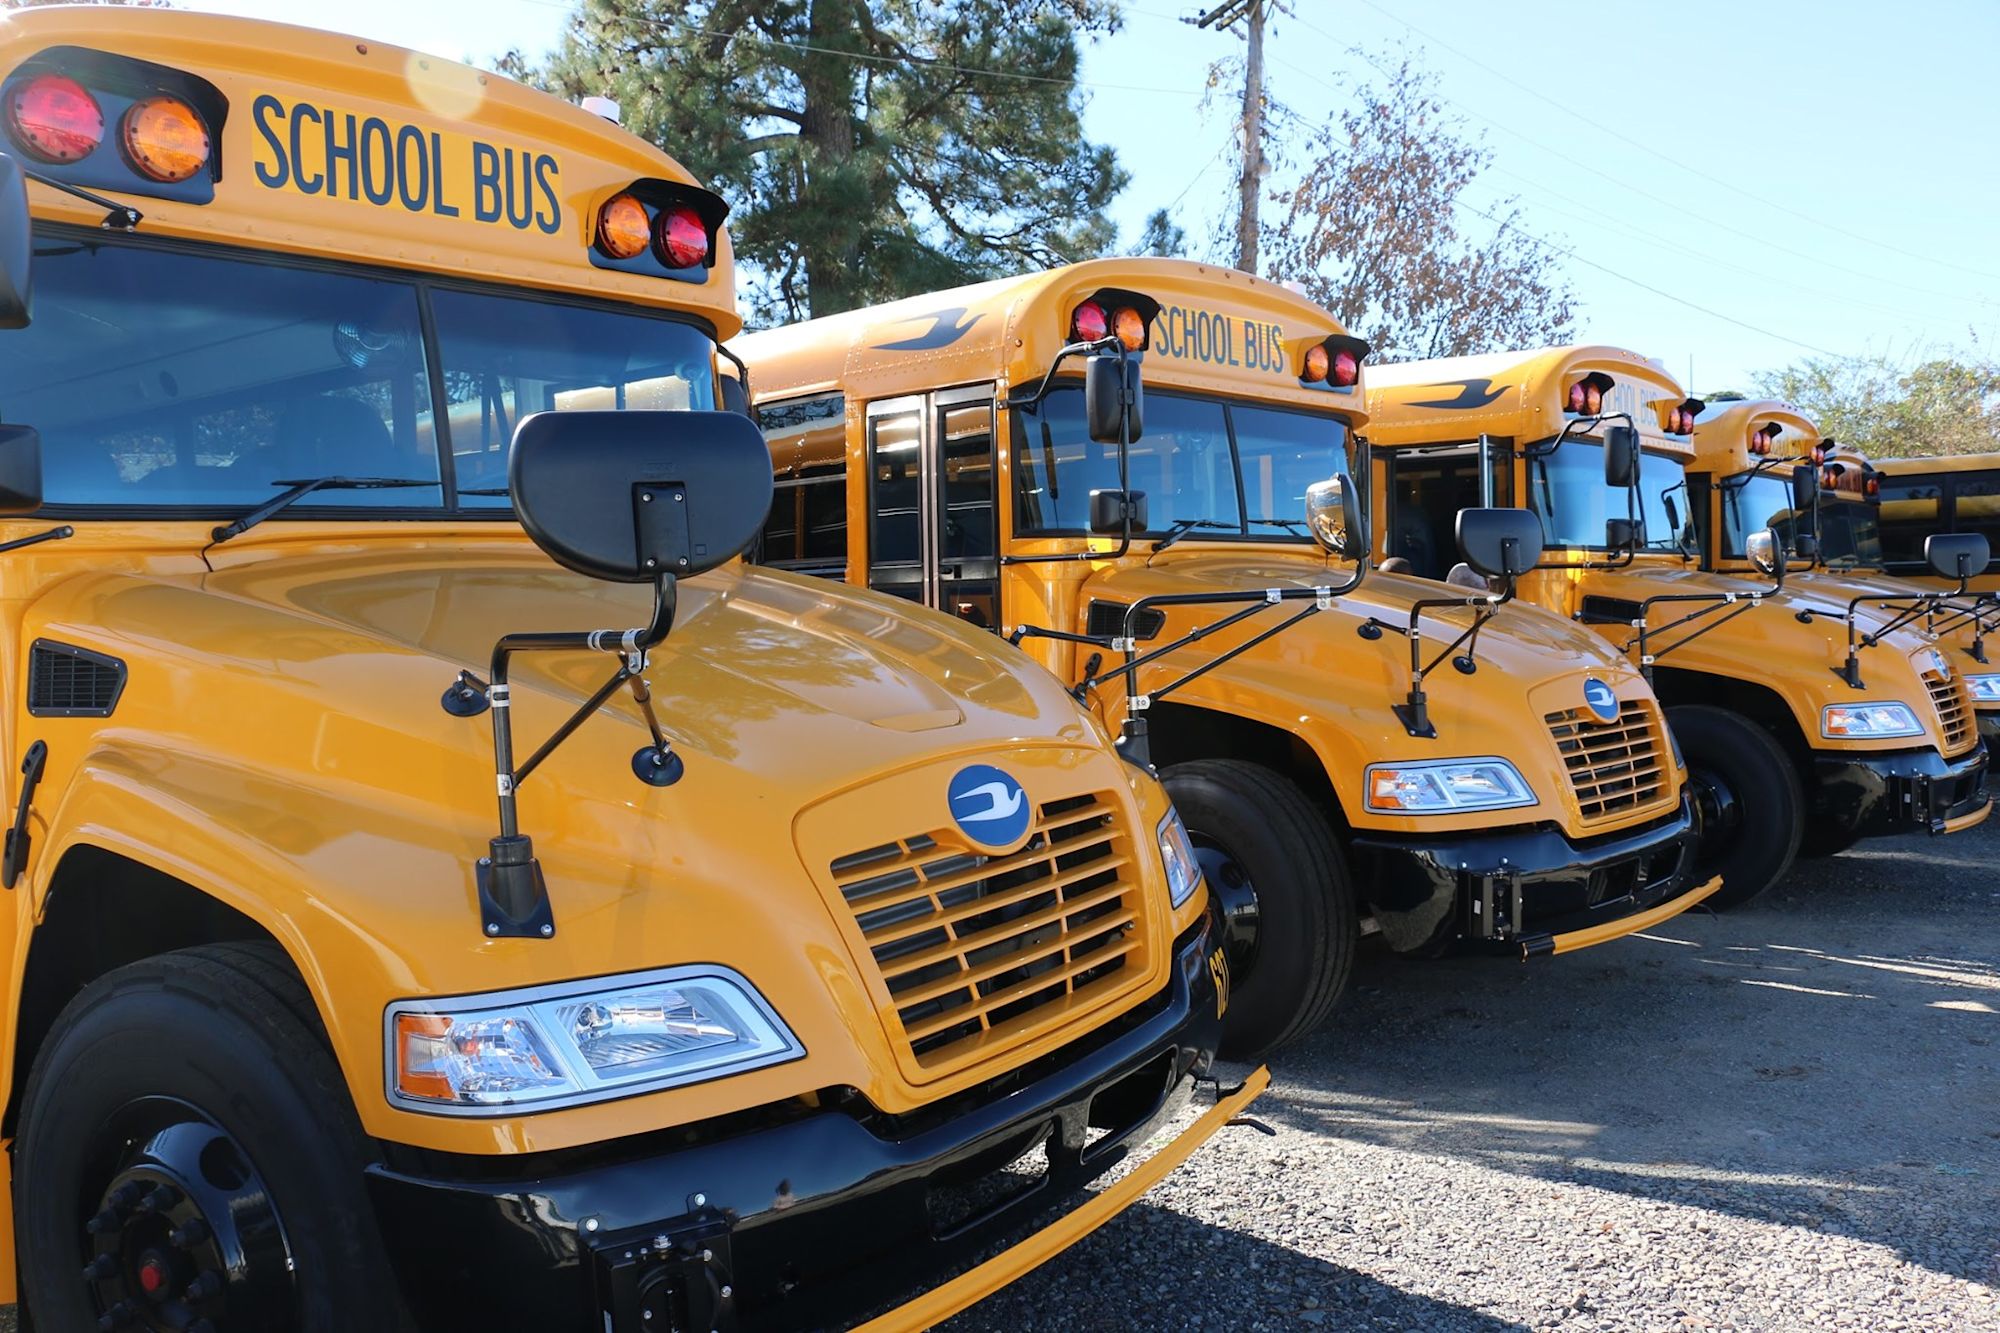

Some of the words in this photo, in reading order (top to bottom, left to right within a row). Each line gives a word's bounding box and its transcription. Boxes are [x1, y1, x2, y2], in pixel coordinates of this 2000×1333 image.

[252, 94, 459, 218] SCHOOL
[473, 141, 561, 235] BUS
[1154, 303, 1240, 367] SCHOOL
[1244, 320, 1284, 374] BUS
